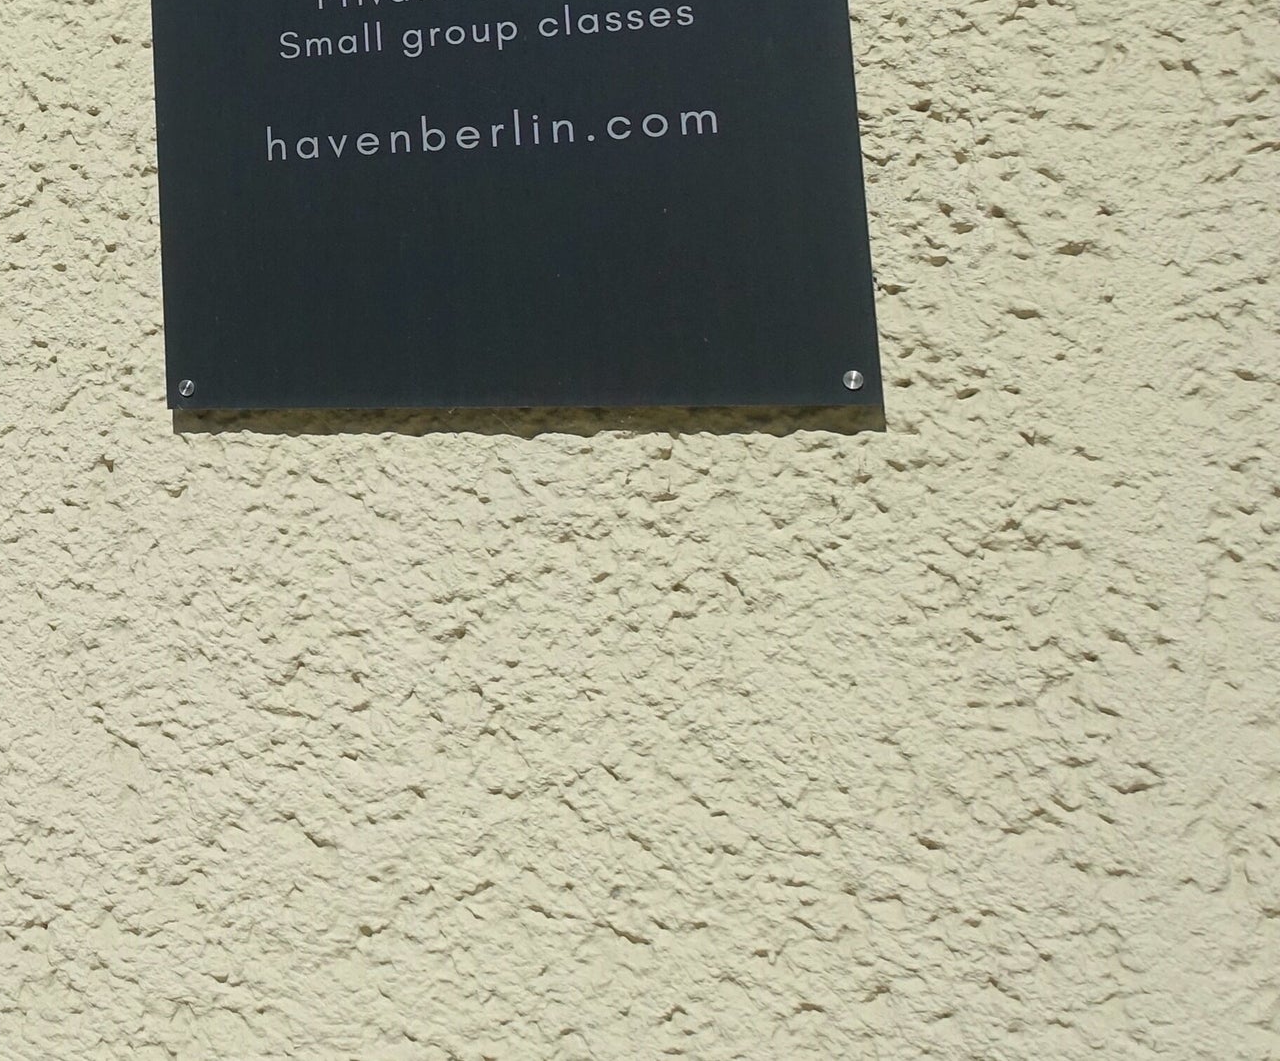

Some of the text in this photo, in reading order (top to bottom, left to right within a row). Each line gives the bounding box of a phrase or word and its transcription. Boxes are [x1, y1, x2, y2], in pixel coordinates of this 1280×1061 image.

[279, 4, 694, 59] Small group classes
[266, 106, 718, 161] havenberlin.com
